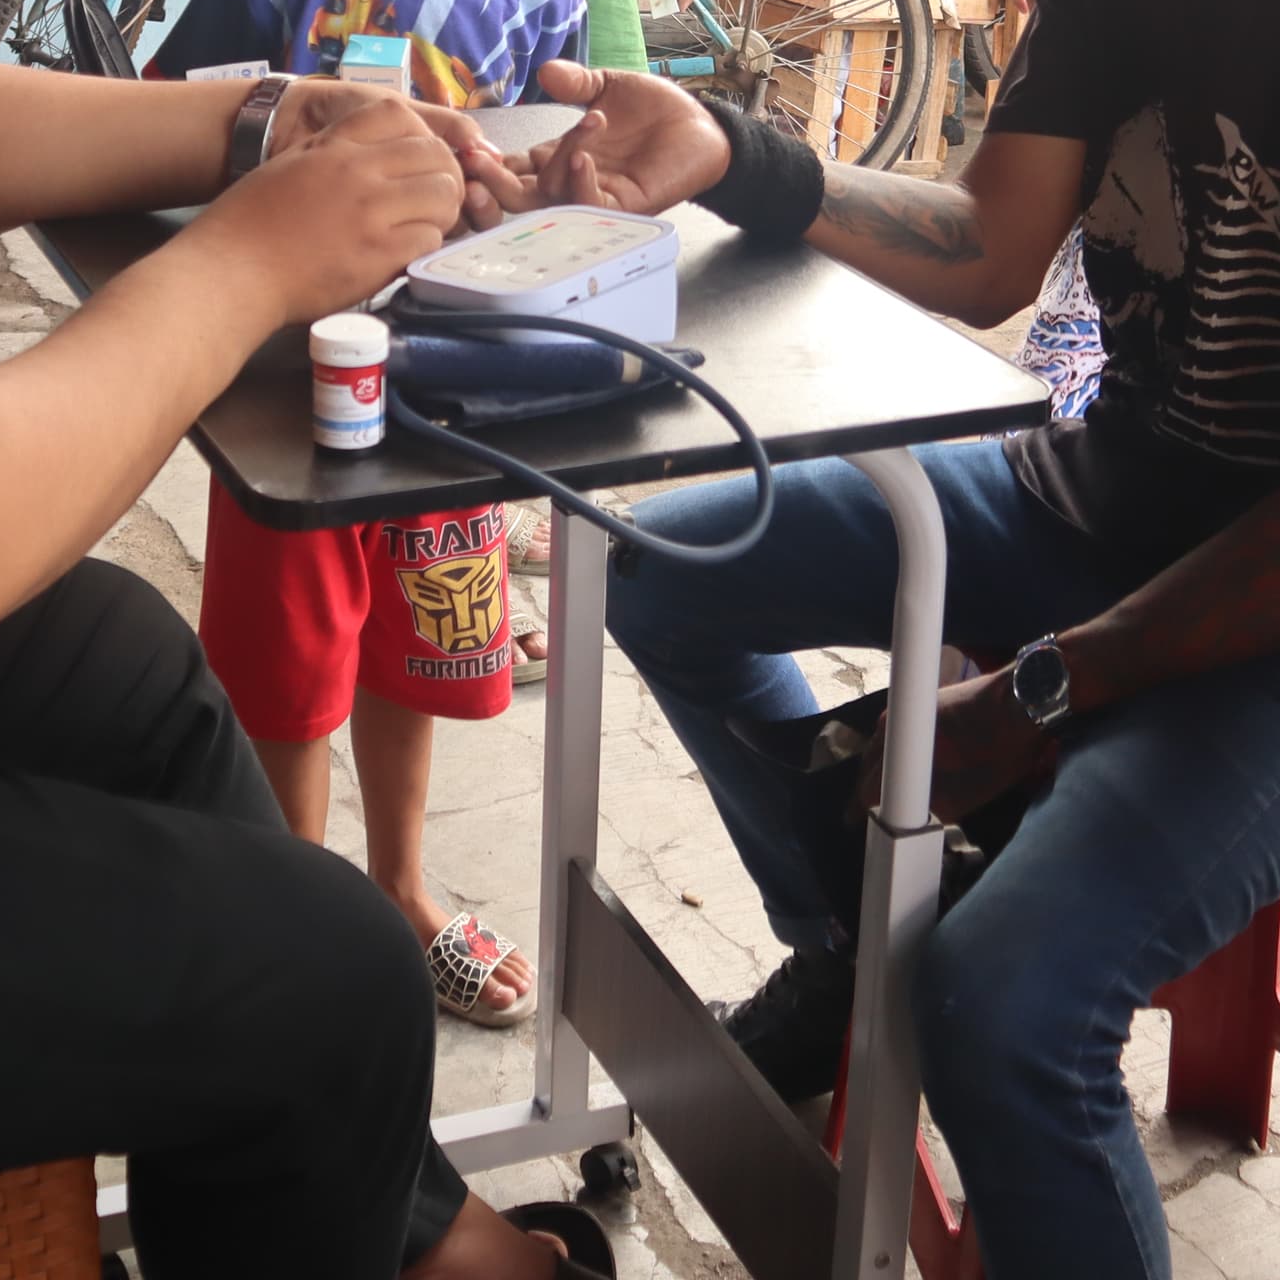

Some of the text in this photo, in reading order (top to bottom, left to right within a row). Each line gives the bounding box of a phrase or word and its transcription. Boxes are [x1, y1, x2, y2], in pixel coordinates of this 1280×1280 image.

[356, 375, 377, 396] 25
[381, 502, 505, 562] TRANS
[406, 642, 510, 681] FORMERS
